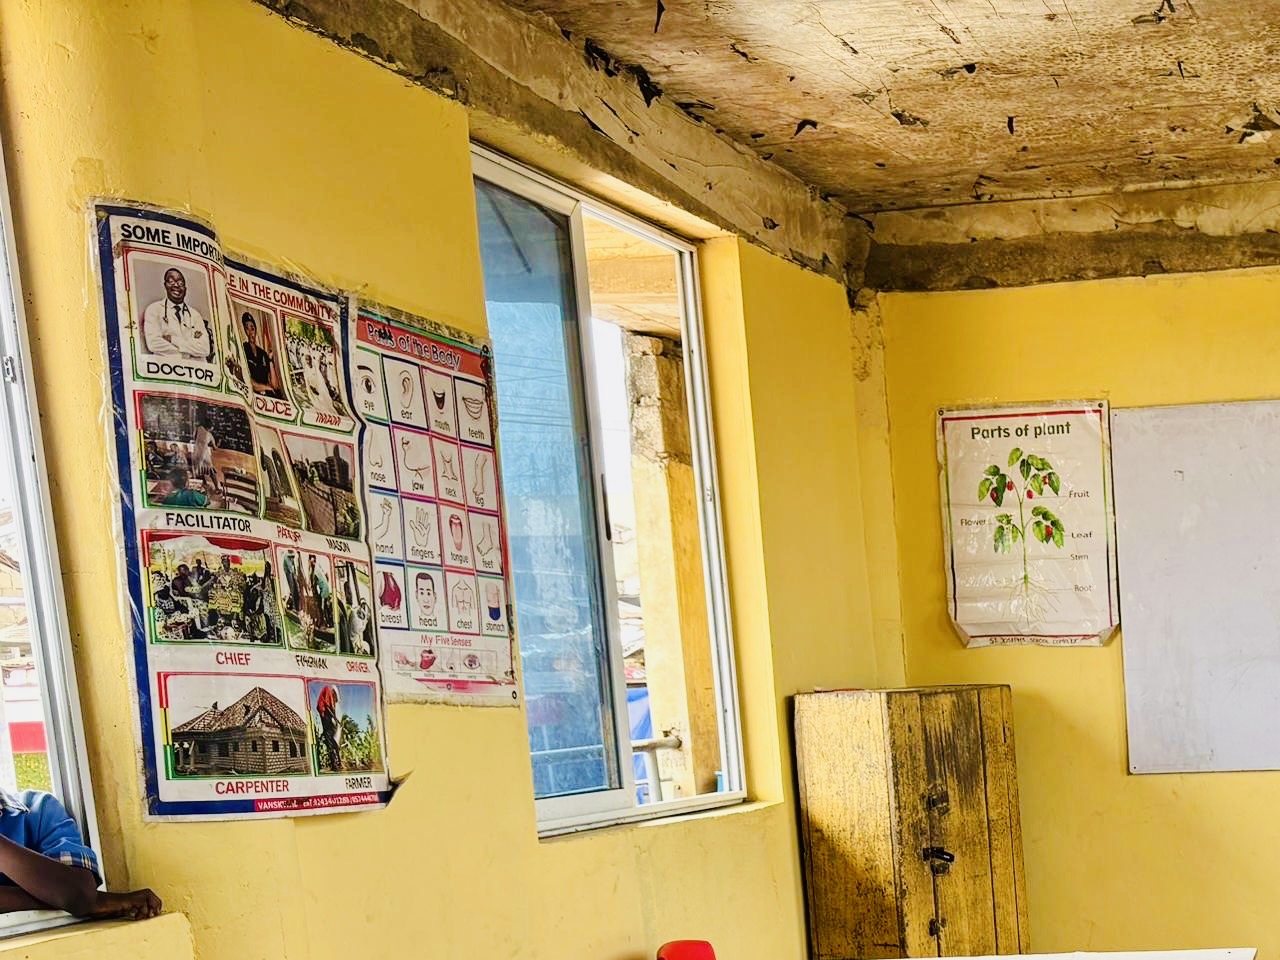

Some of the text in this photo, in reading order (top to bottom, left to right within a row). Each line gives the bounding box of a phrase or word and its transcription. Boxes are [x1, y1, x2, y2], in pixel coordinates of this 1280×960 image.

[120, 223, 172, 246] SOME
[239, 277, 249, 293] IN
[251, 281, 272, 300] THE
[273, 290, 333, 320] COMMUNITY
[412, 337, 431, 358] the
[431, 344, 461, 371] Body
[146, 361, 215, 383] DOCTOR
[363, 400, 375, 412] eye
[400, 409, 413, 420] ear
[468, 427, 486, 441] teeth
[970, 420, 1072, 440] Parts of plant
[370, 471, 387, 484] nose
[1068, 490, 1090, 499] Fruit
[165, 511, 252, 534] FACILITATOR
[960, 518, 987, 526] Flower
[1071, 531, 1093, 540] Leaf
[375, 543, 395, 555] hand
[411, 547, 435, 560] fingers
[450, 552, 470, 565] tongue
[1070, 553, 1089, 561] Stem
[482, 558, 494, 569] feet
[1074, 584, 1092, 592] Root
[380, 613, 403, 625] breast
[418, 616, 438, 628] head
[456, 619, 473, 630] chest
[485, 622, 505, 632] stomach
[421, 634, 434, 646] My
[215, 651, 252, 667] CHIEF
[215, 779, 290, 796] CARPENTER
[345, 776, 373, 791] FARMER
